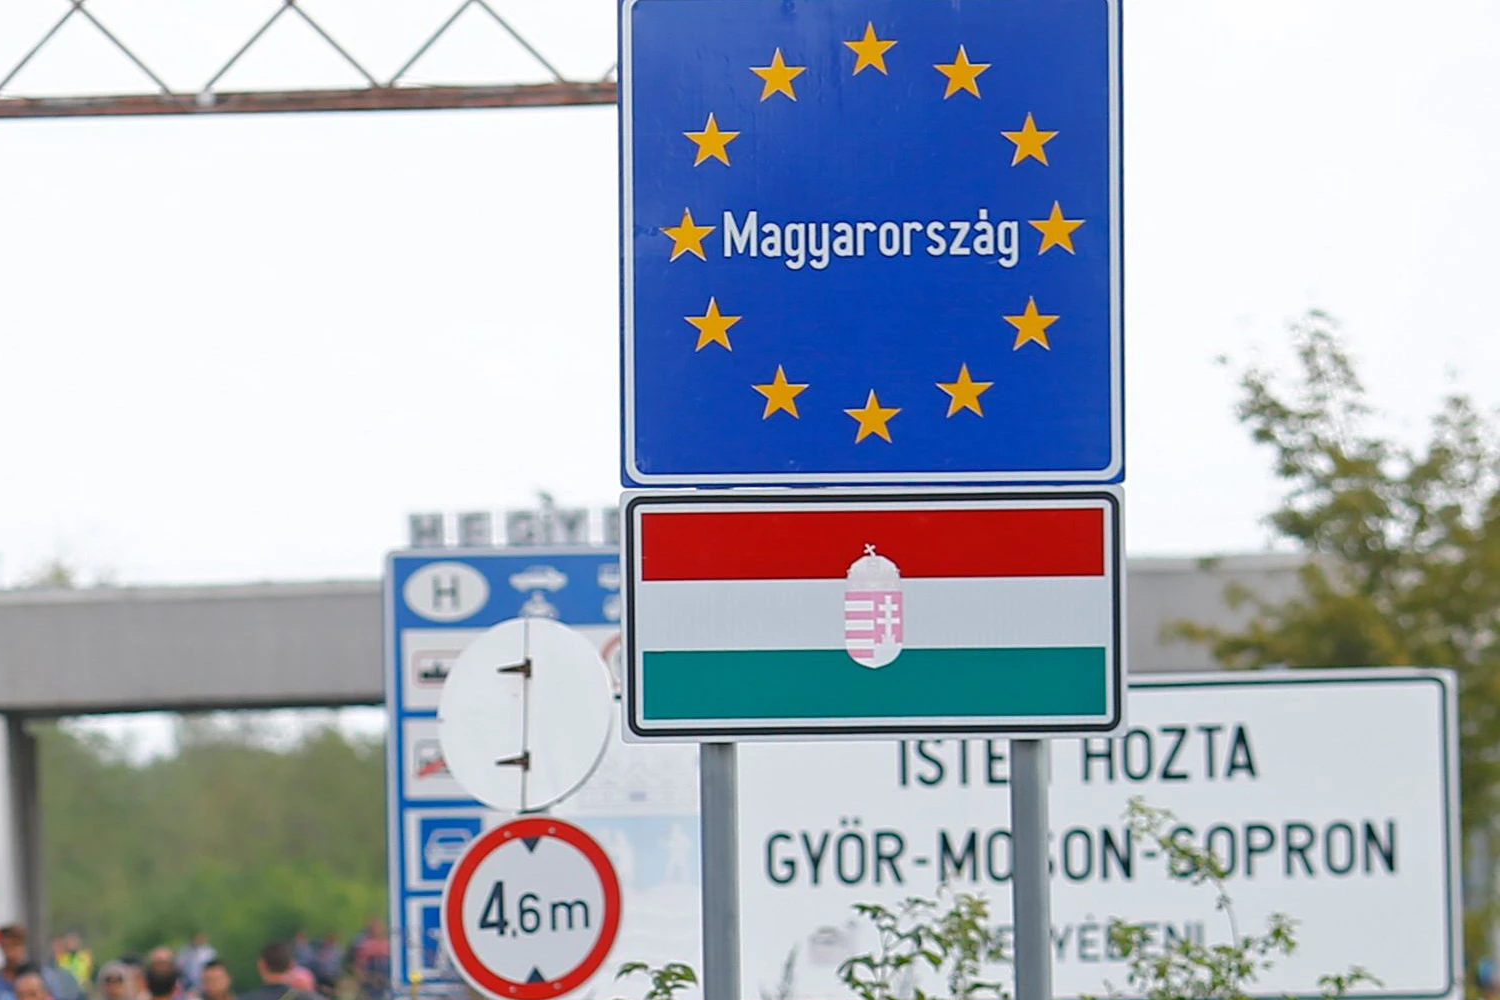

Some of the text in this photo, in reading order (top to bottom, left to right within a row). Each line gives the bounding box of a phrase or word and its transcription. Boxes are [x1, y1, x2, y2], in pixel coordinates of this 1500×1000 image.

[722, 208, 1020, 270] Magyarország
[431, 574, 461, 610] H
[899, 723, 1258, 787] ISTE HOZTA
[766, 817, 1397, 886] GYÖR-MOON-SOPRON
